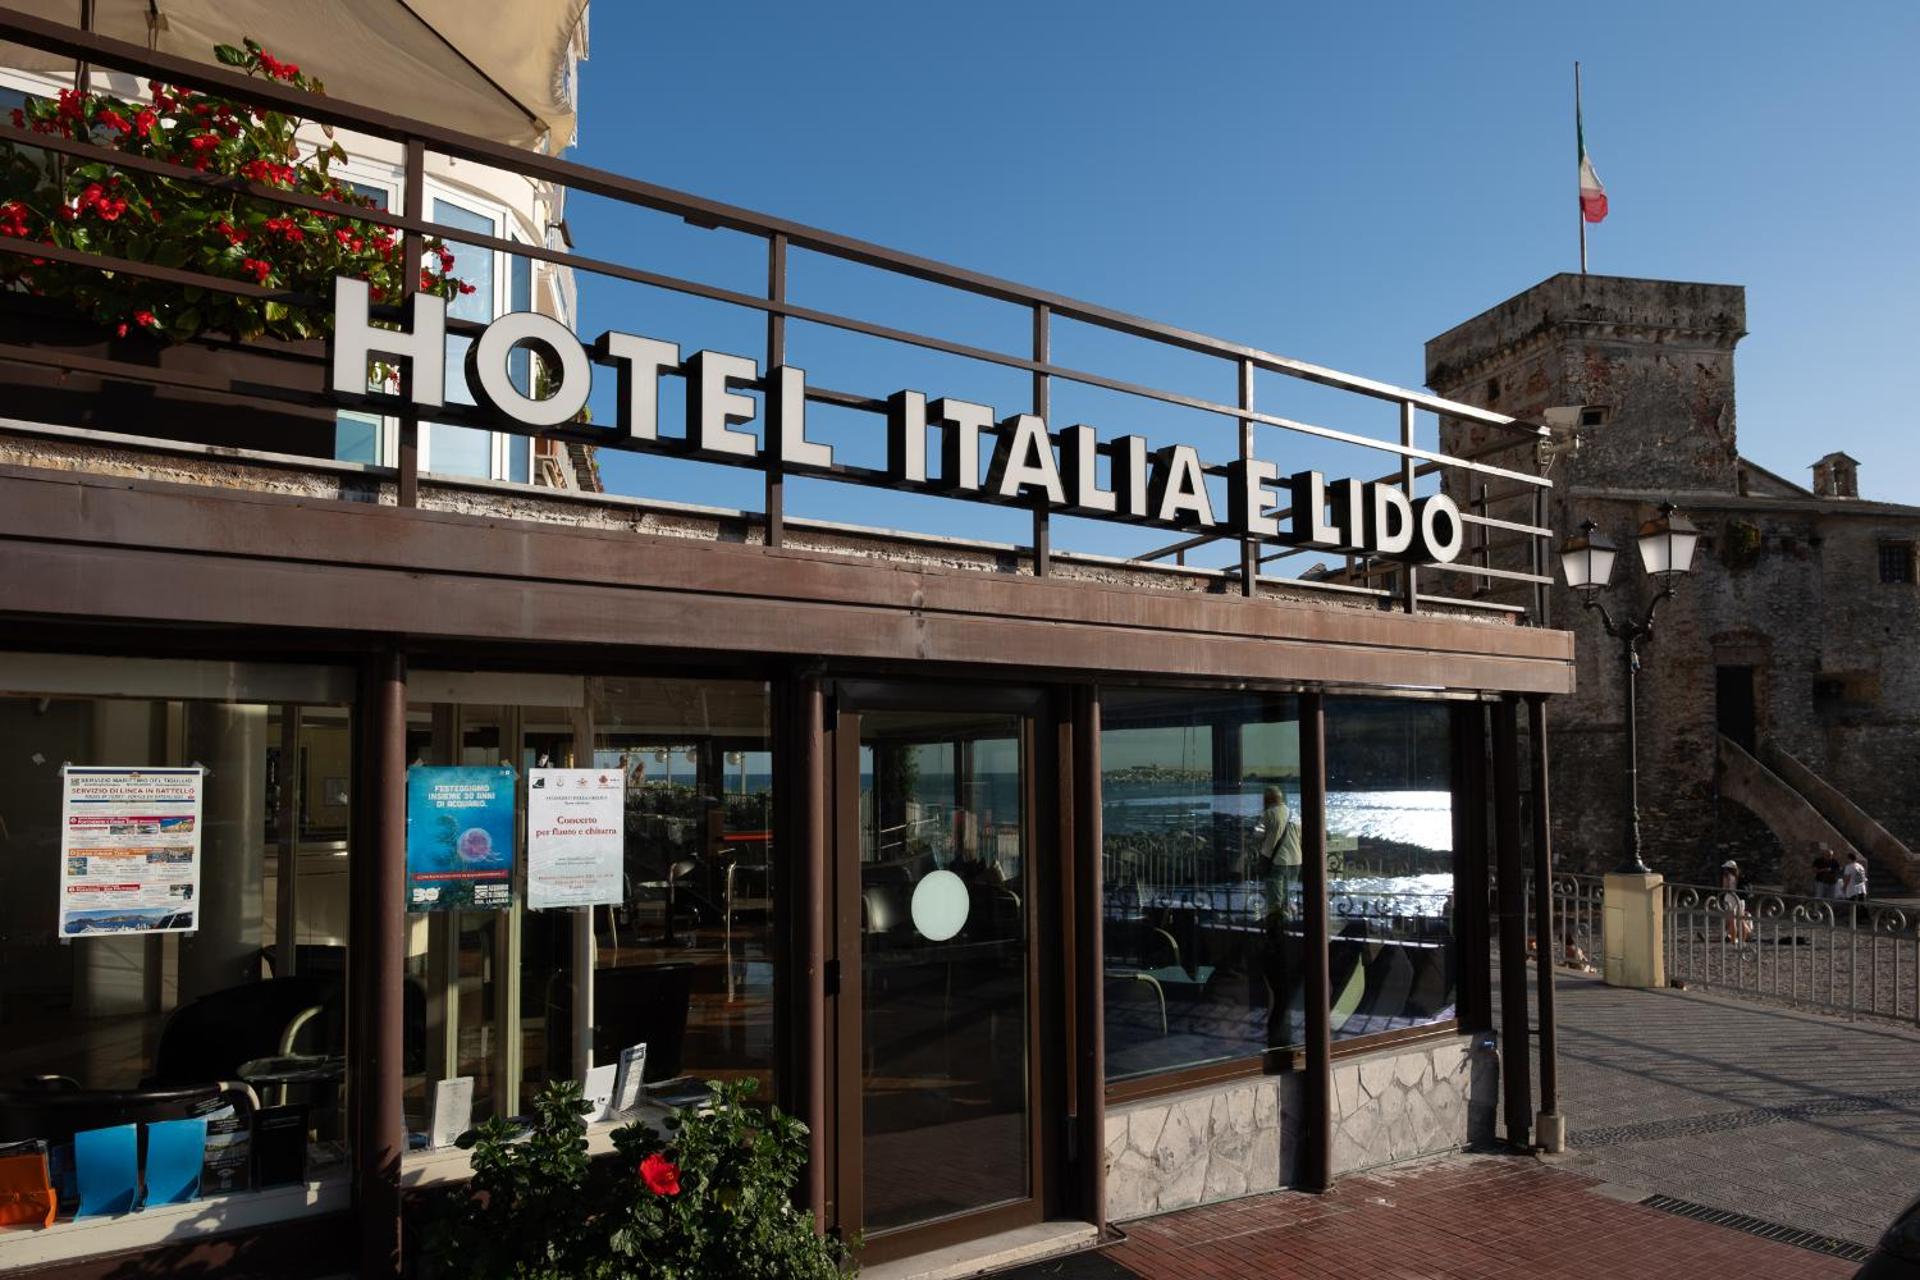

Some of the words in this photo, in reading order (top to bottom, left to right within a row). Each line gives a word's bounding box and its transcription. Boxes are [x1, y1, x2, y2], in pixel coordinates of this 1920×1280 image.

[332, 275, 834, 470] HOTEL
[900, 388, 1216, 527] ITALIA
[1244, 457, 1279, 537] E
[1309, 470, 1464, 565] LIDO
[557, 816, 598, 824] Concerto
[536, 829, 550, 838] per
[552, 827, 577, 835] flauto
[585, 827, 617, 835] chitarra
